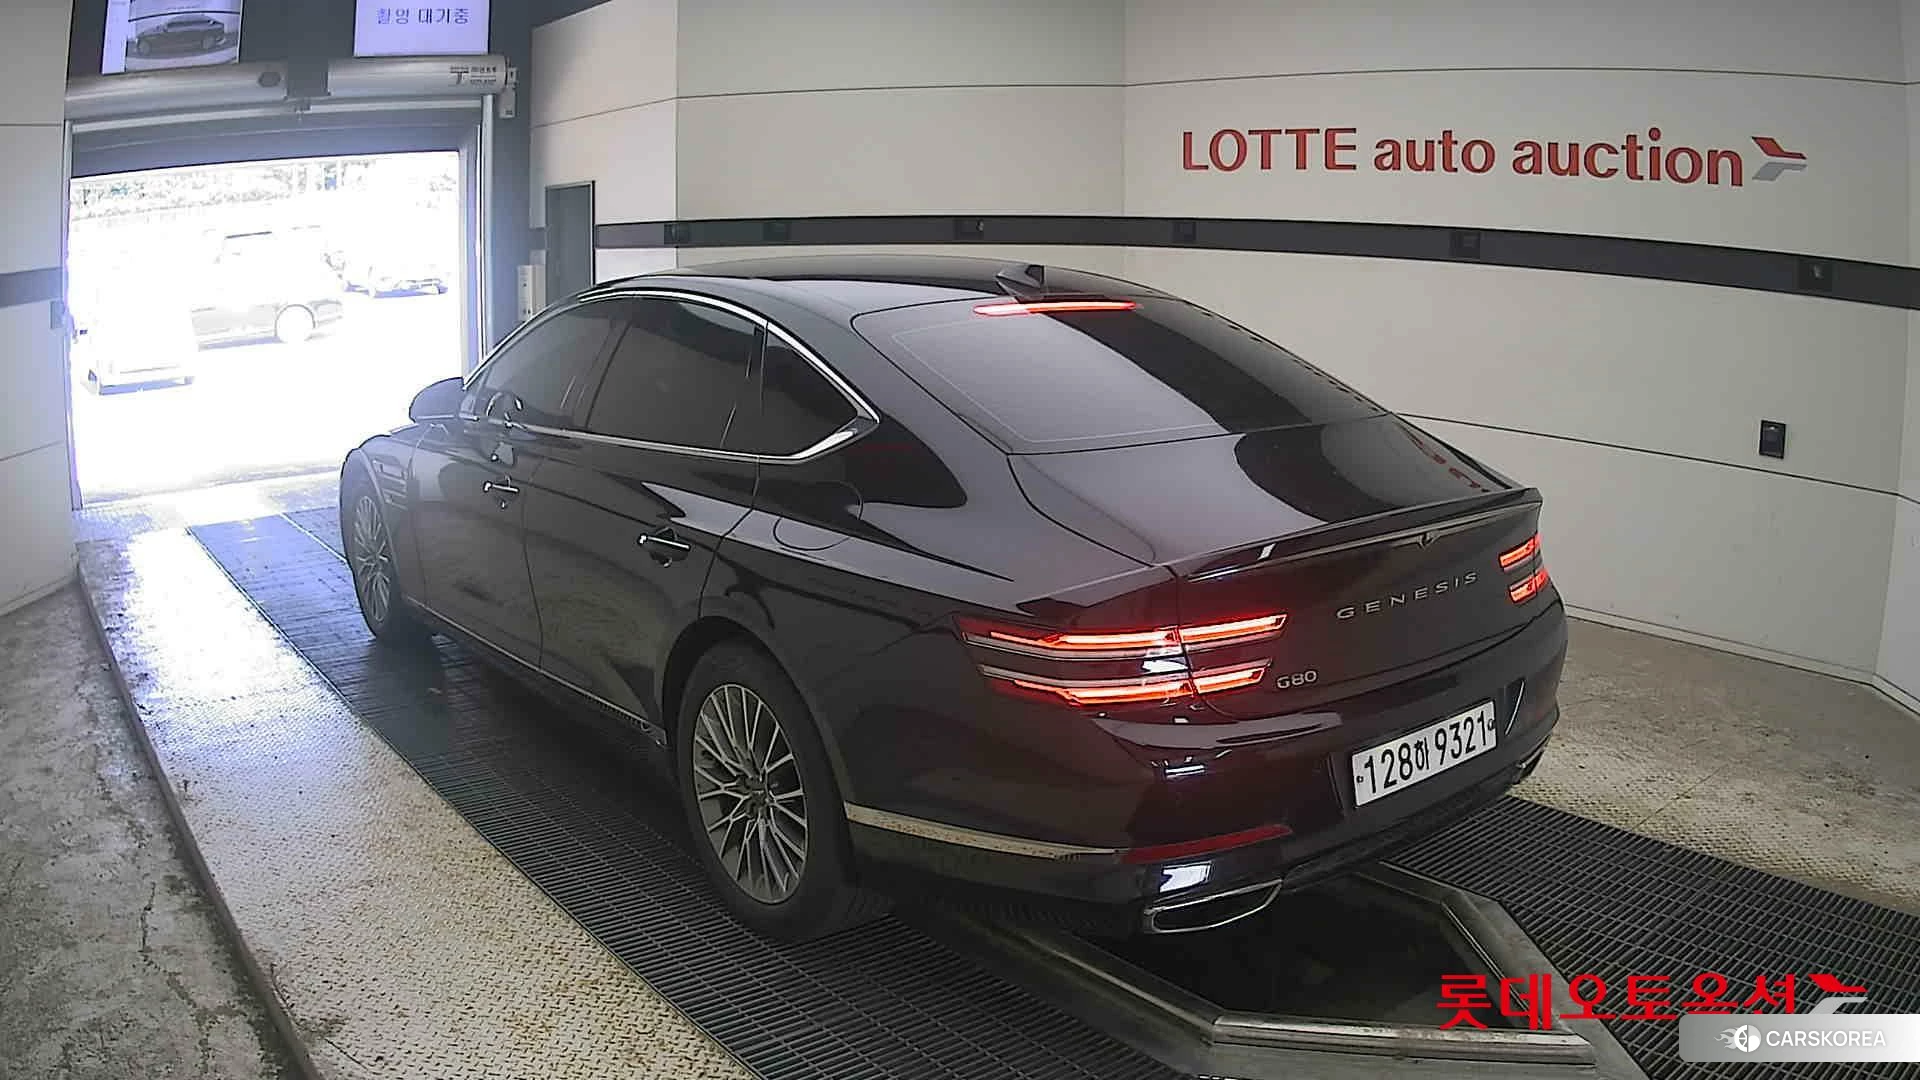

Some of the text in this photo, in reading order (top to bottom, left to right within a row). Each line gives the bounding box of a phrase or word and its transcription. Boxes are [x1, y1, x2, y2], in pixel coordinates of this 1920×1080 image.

[418, 7, 469, 25] 대기중
[1182, 127, 1744, 187] LOTTE auto auction
[1335, 571, 1478, 620] GENESIS
[1276, 669, 1318, 690] G80
[1434, 710, 1487, 766] 9321
